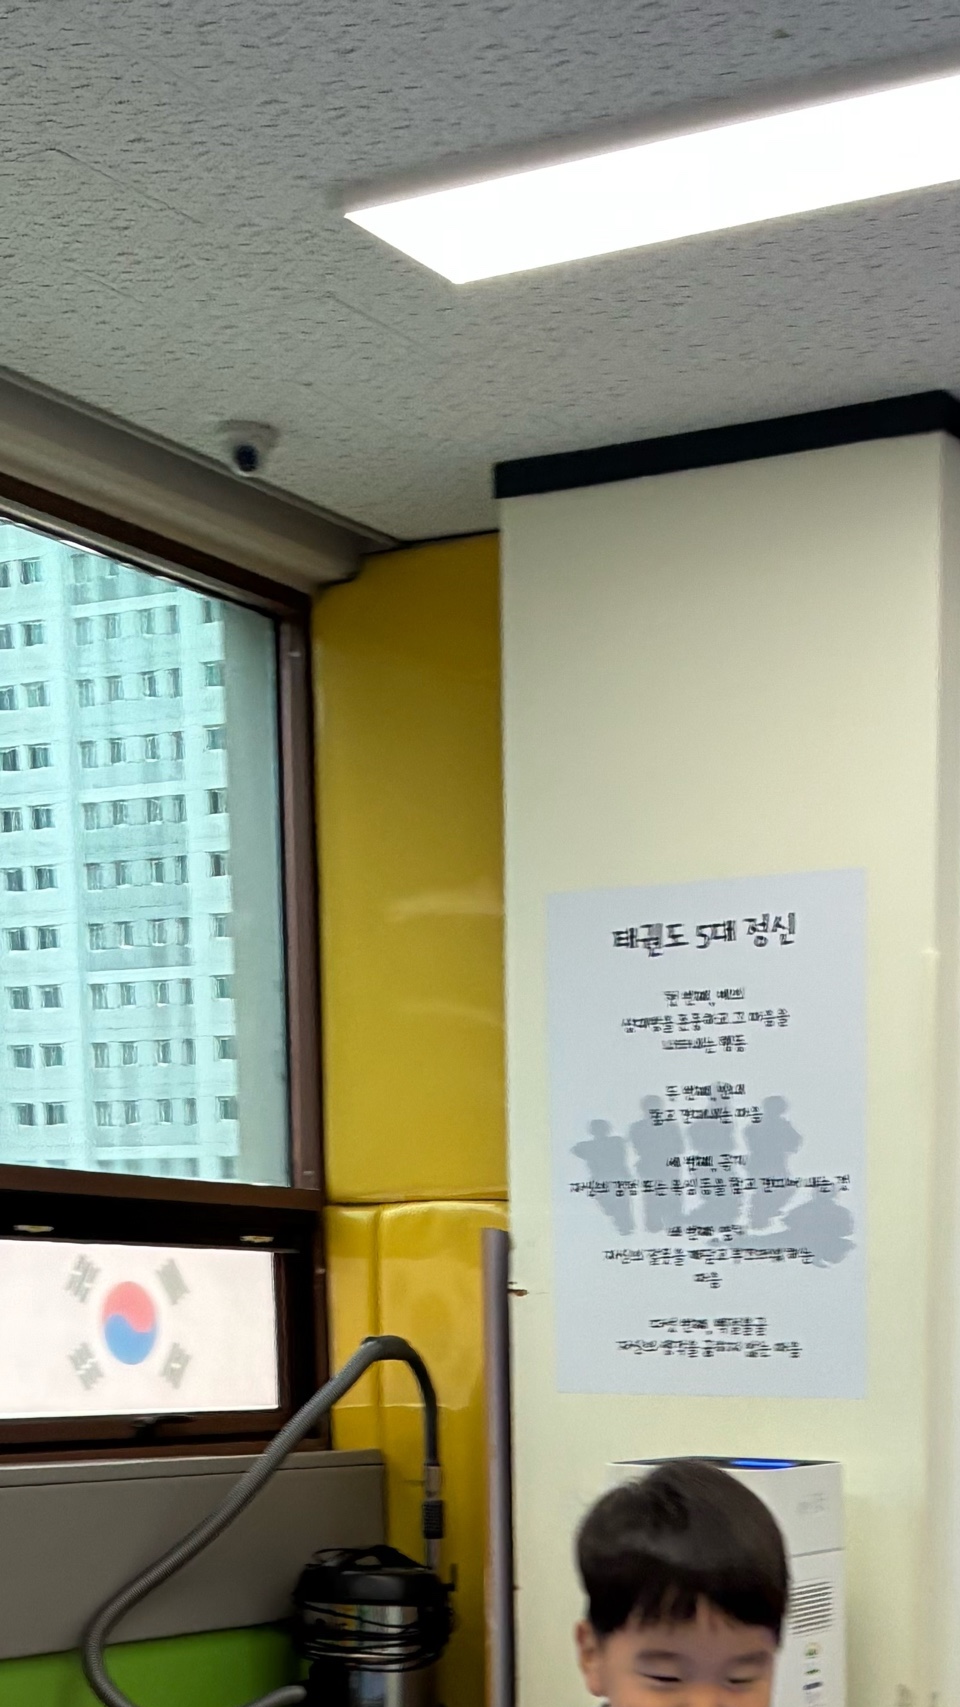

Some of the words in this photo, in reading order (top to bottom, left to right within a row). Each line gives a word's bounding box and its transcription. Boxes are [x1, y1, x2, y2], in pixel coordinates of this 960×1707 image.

[611, 923, 689, 957] 태권도
[695, 919, 737, 949] 5대
[742, 911, 797, 948] 정신
